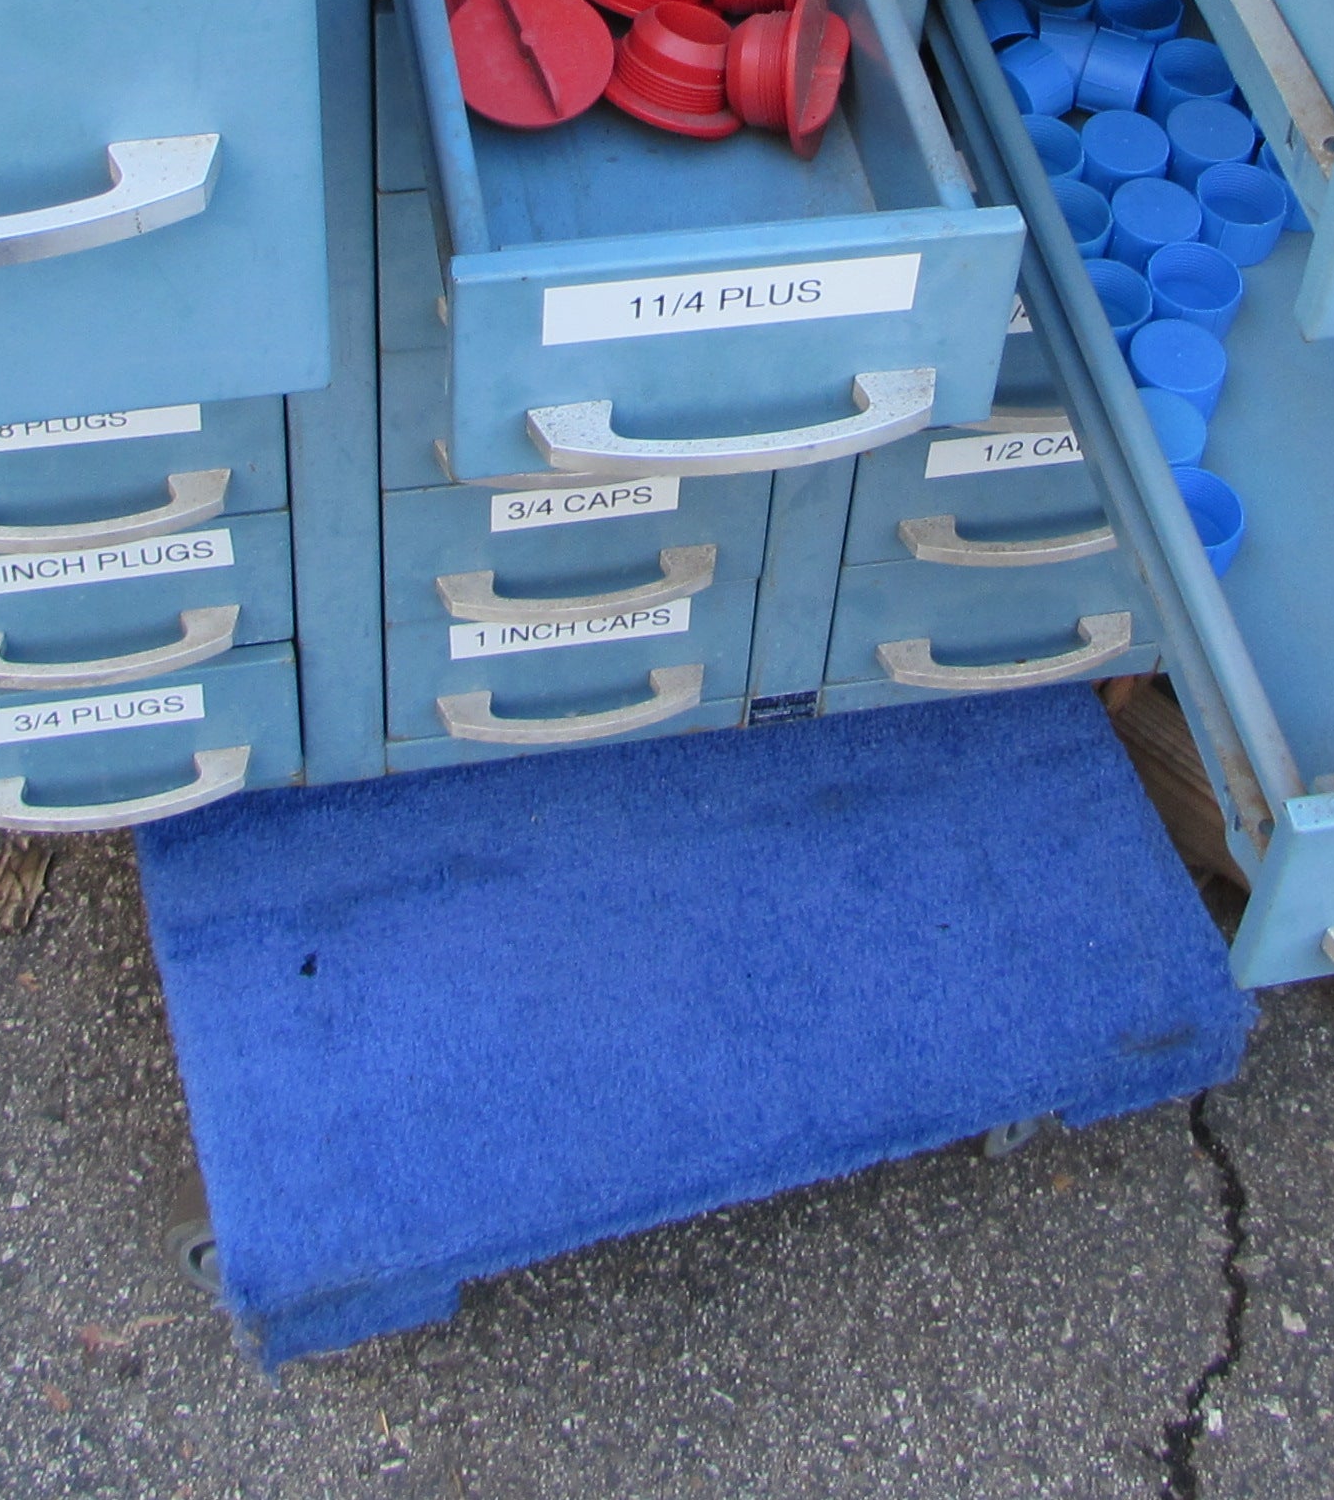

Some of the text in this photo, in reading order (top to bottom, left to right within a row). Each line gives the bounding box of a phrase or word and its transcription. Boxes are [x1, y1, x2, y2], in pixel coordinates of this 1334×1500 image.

[718, 279, 822, 312] PLUS
[24, 410, 128, 436] PLUGS
[983, 435, 1081, 463] 1/2 CA
[508, 486, 653, 520] 3/4 CAPS
[1, 555, 85, 583] INCH
[98, 540, 214, 571] PLUGS
[474, 608, 671, 647] 1 INCH CAPS
[14, 695, 185, 732] 3/4 PLUGS
